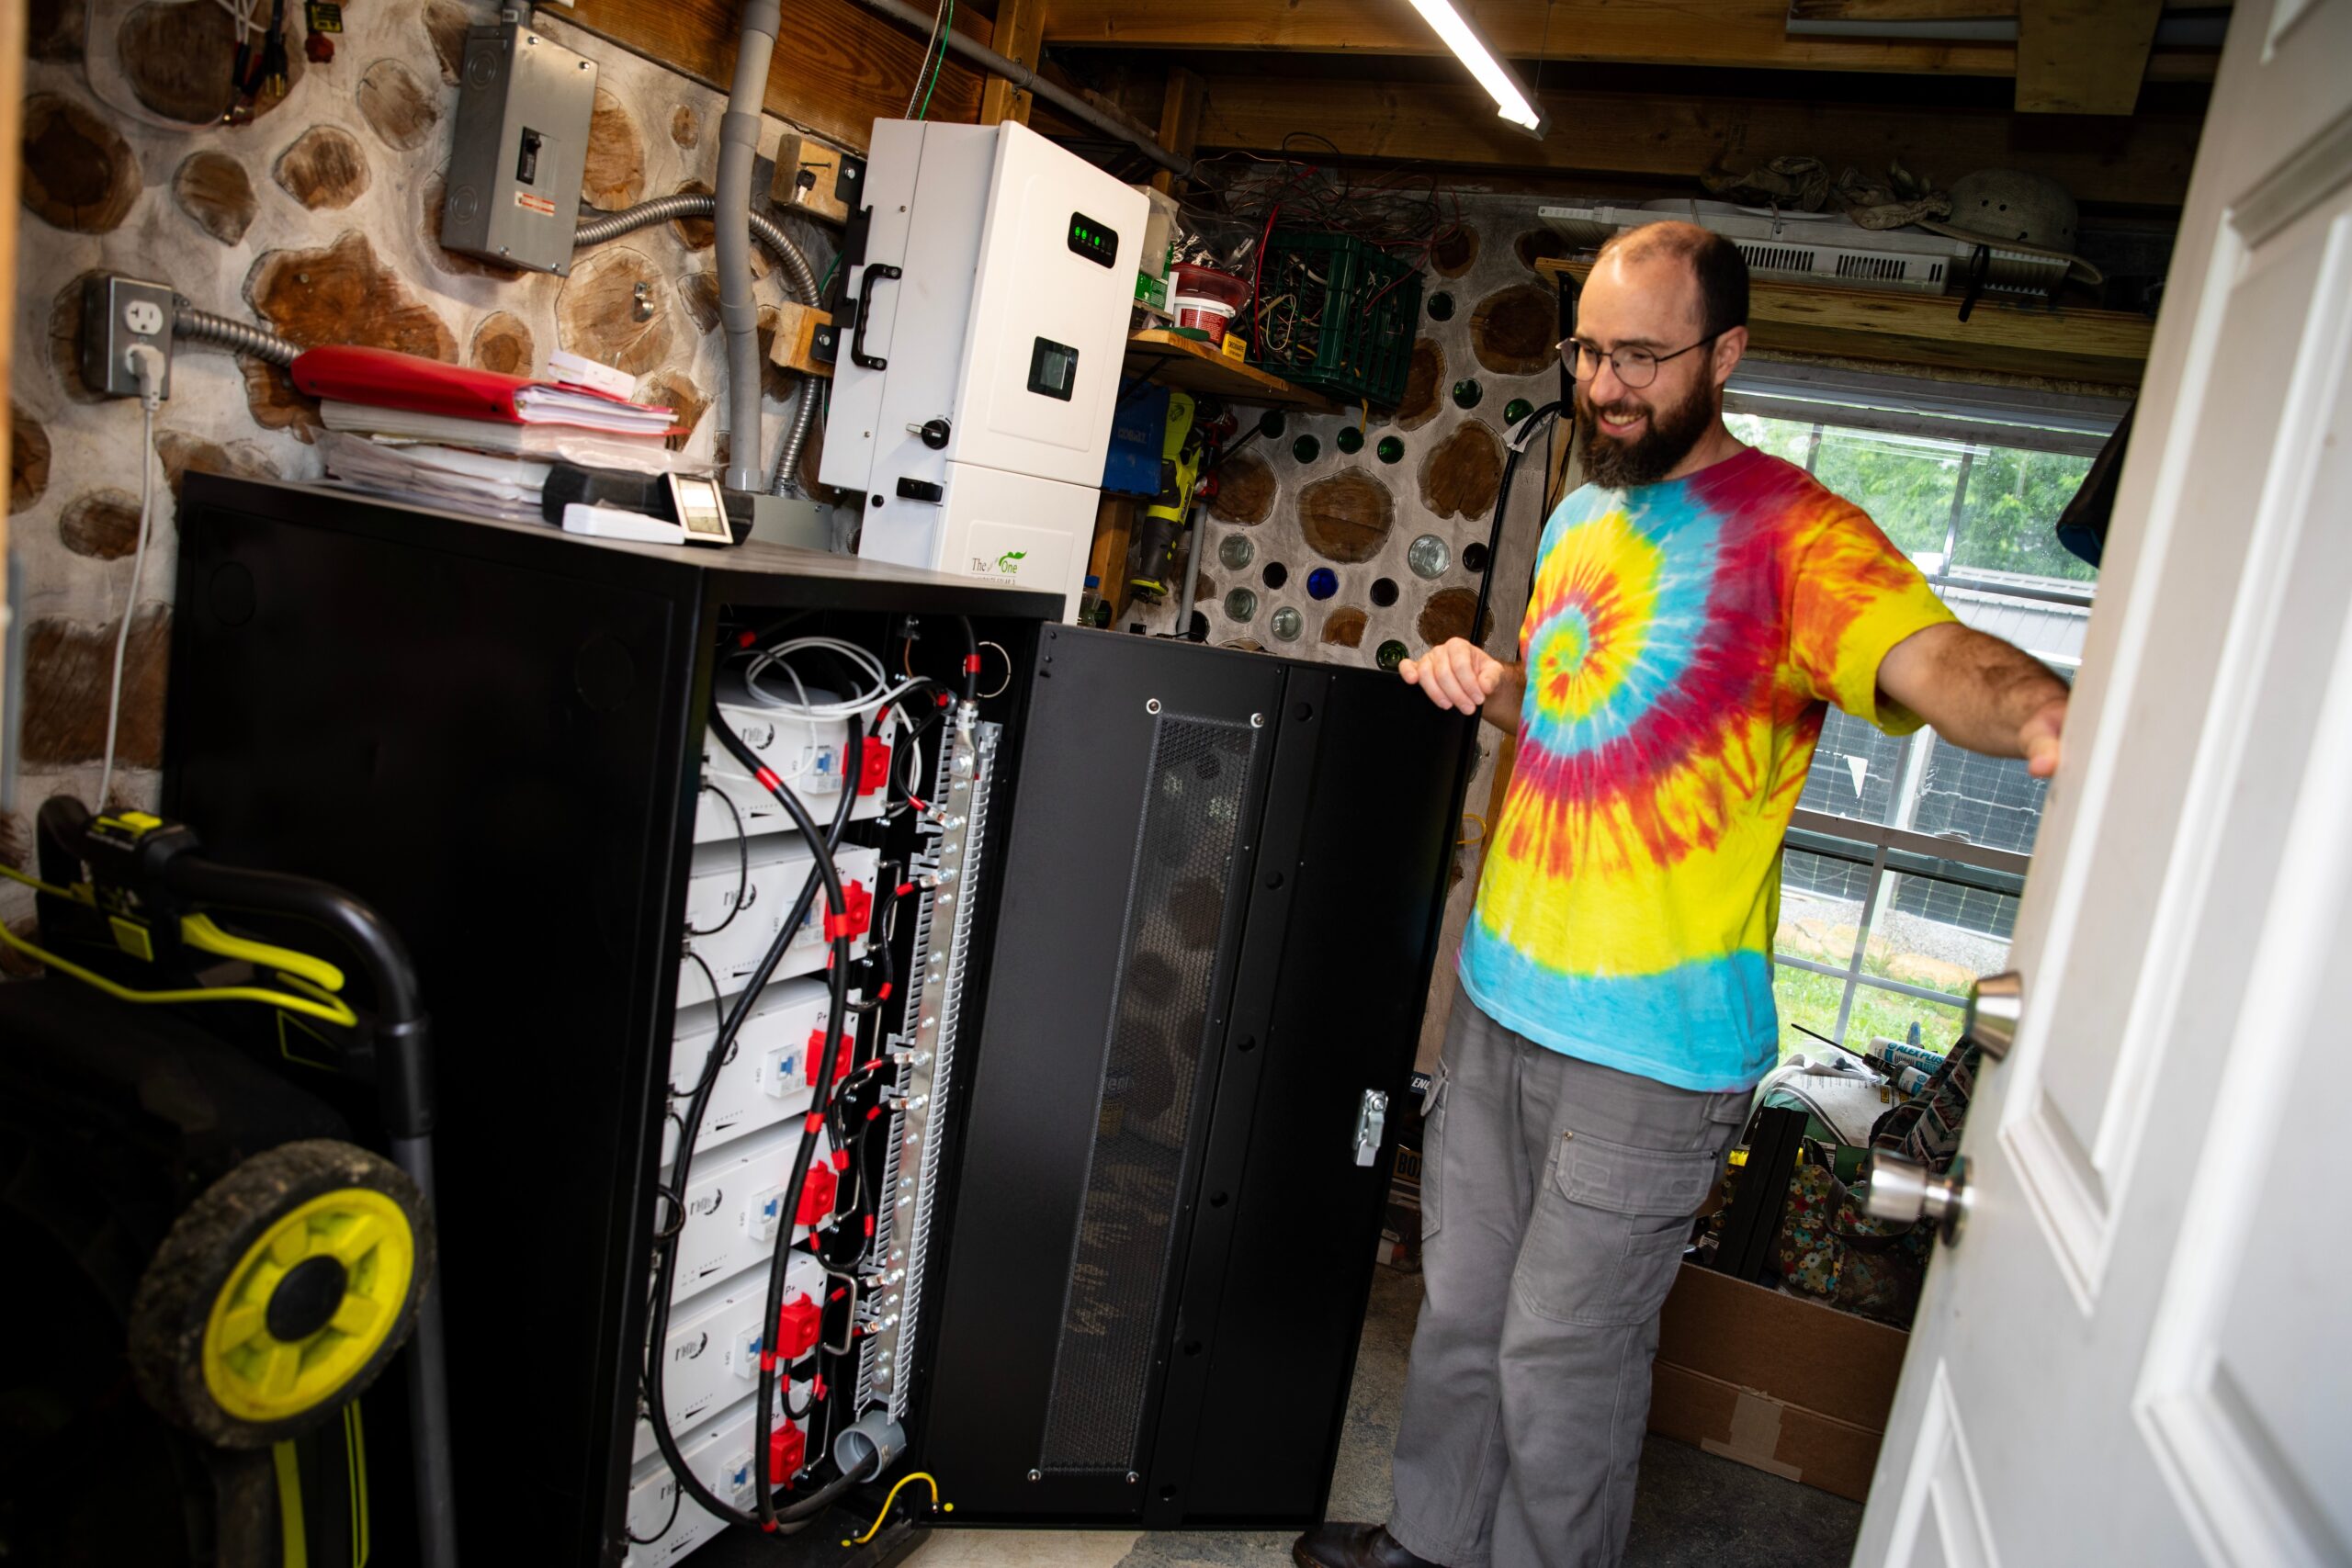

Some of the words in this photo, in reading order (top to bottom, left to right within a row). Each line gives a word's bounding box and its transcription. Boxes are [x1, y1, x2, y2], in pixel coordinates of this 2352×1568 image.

[972, 558, 987, 571] The
[1001, 560, 1018, 574] One
[817, 1011, 827, 1022] P+
[1896, 1045, 1920, 1056] ALEX
[1920, 1052, 1945, 1065] PLUS
[786, 1285, 796, 1296] P+
